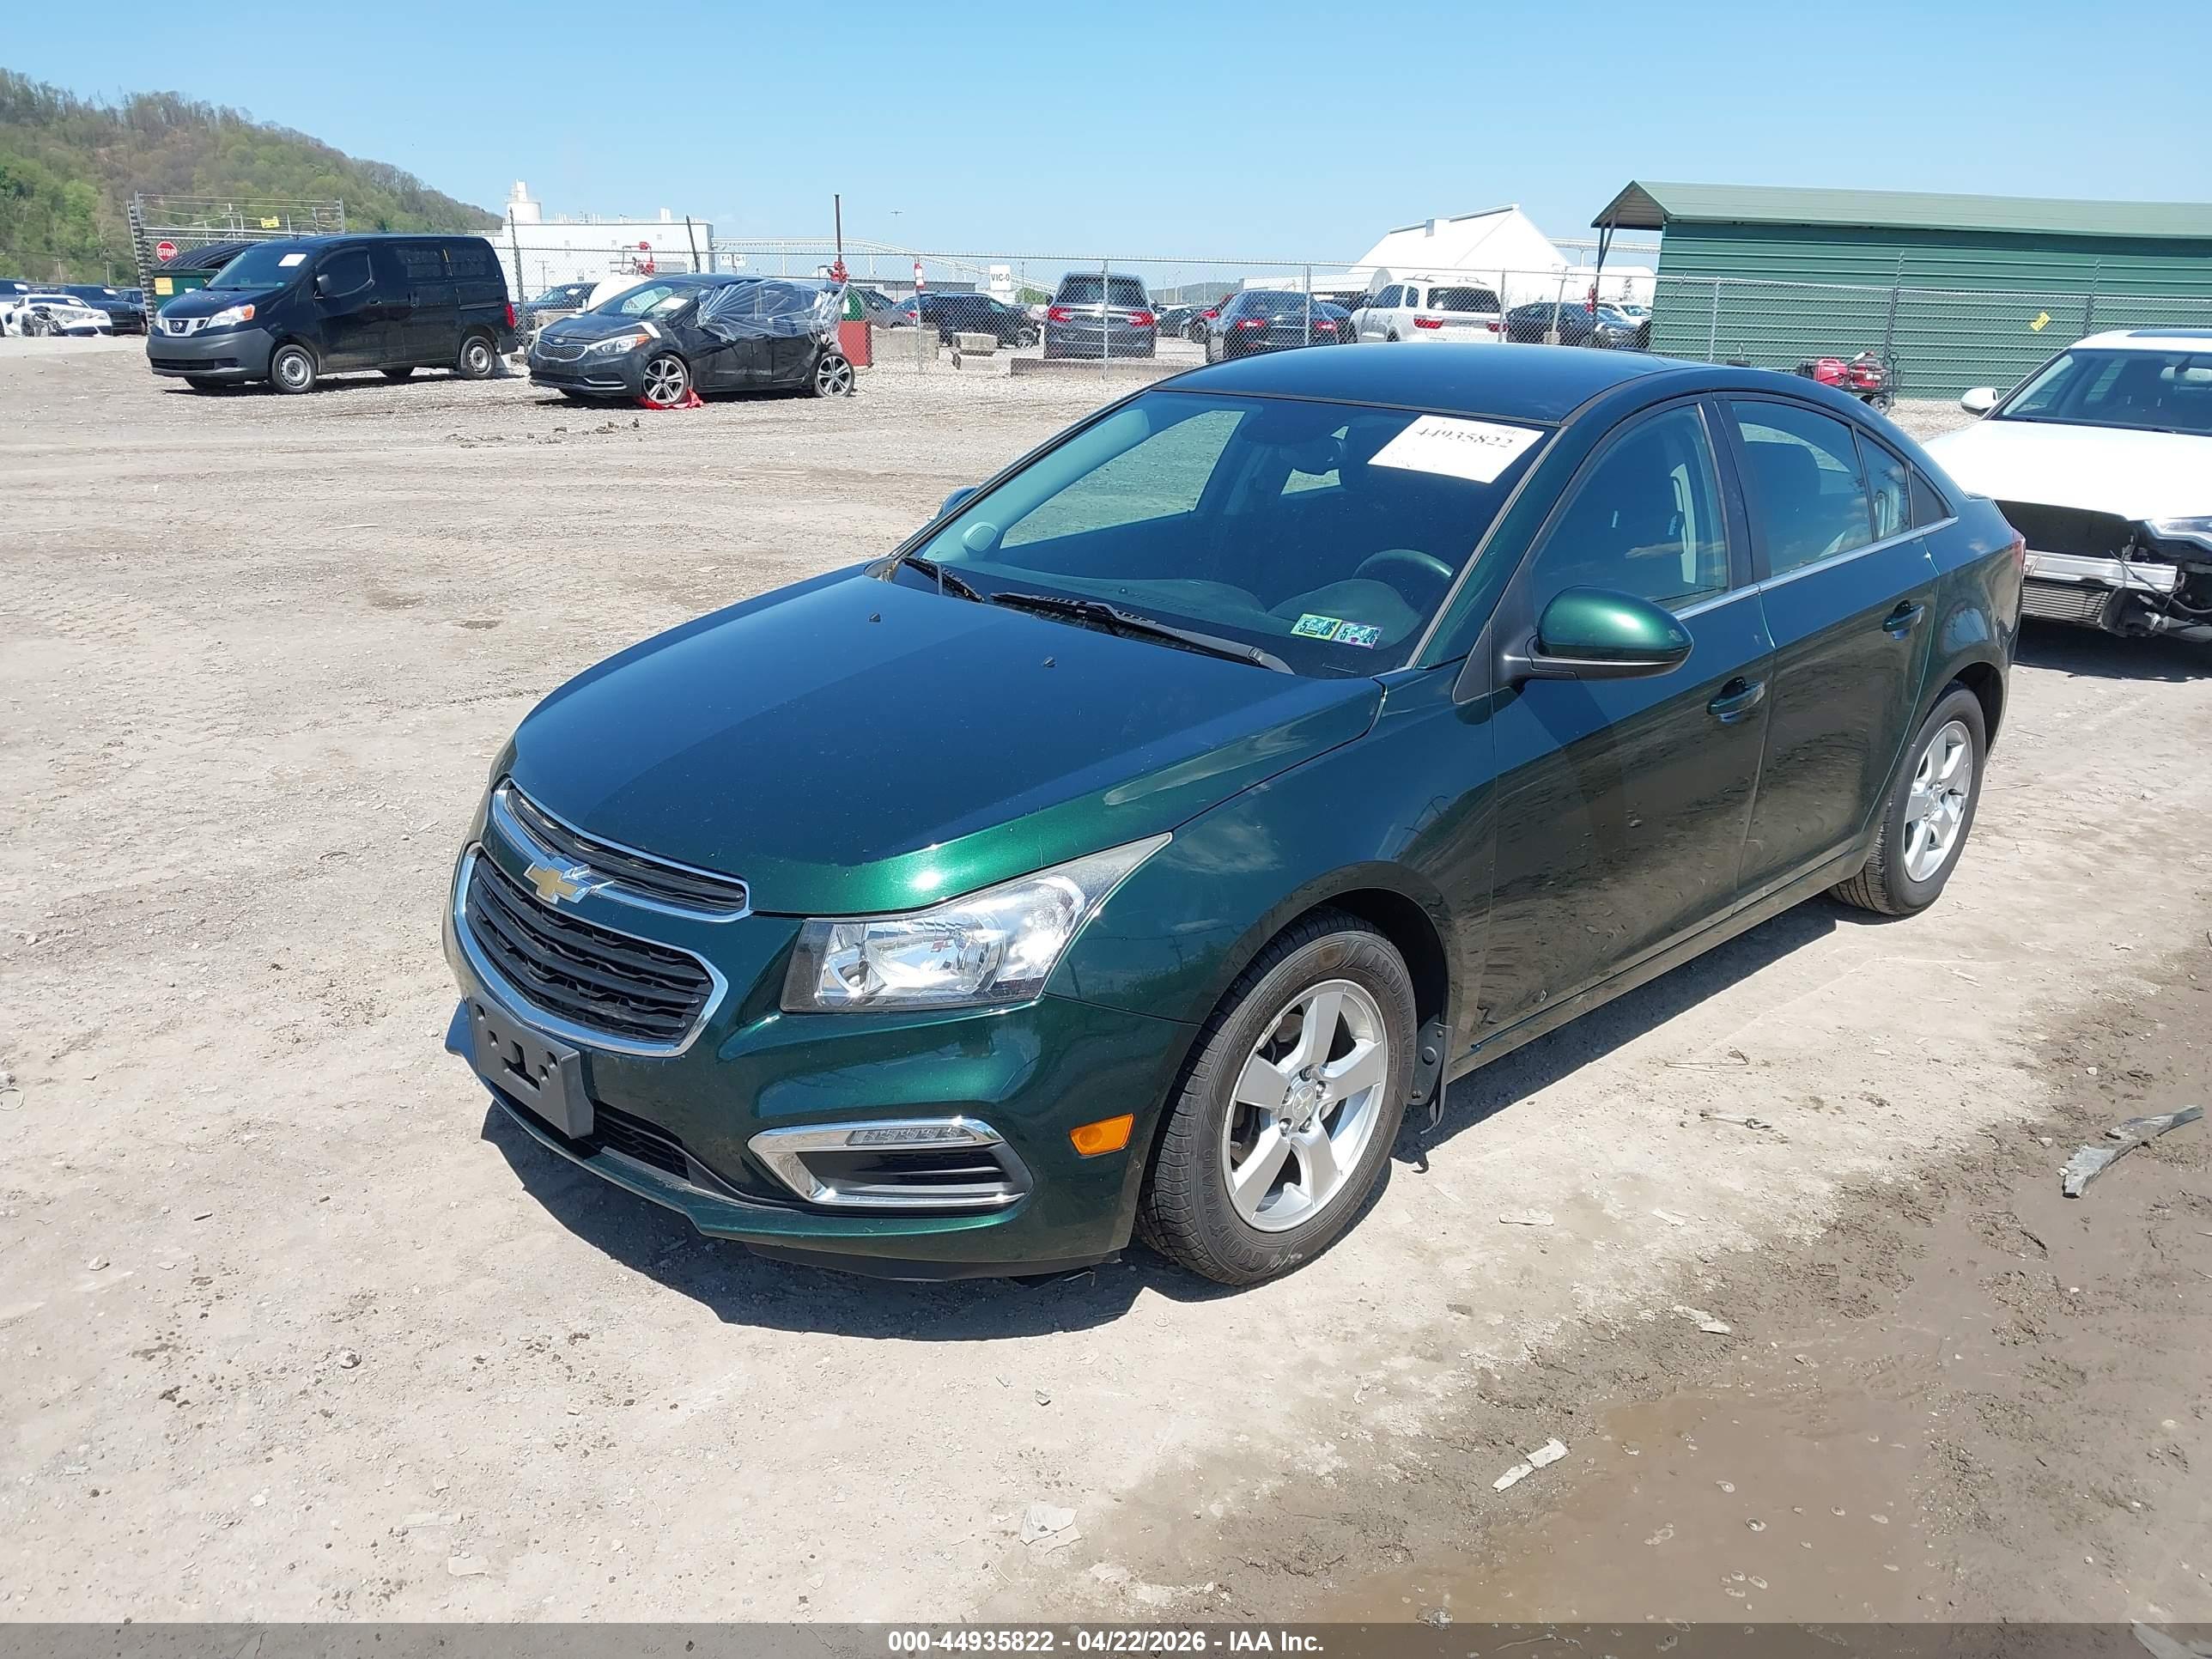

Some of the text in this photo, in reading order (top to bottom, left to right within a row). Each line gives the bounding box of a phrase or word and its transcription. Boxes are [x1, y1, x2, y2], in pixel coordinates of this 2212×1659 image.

[157, 247, 176, 257] STOP
[1416, 427, 1514, 448] 44935822
[1201, 1147, 1264, 1269] GOODYEAR
